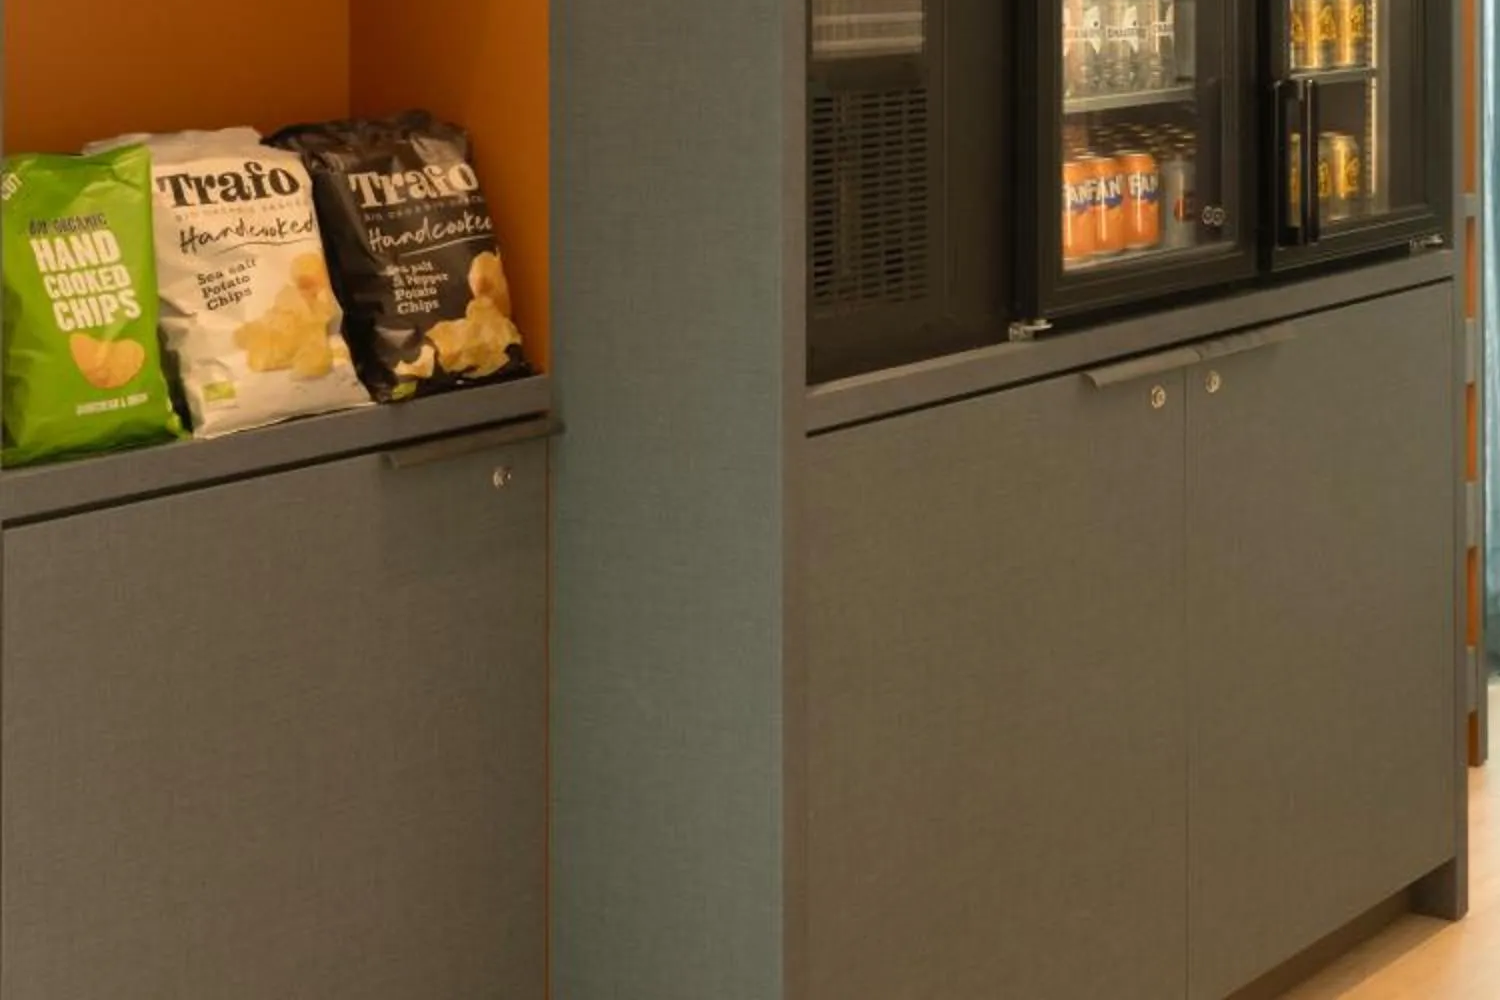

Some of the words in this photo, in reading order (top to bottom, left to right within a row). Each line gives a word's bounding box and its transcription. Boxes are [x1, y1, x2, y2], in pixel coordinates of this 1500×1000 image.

[155, 161, 299, 208] Trafo
[348, 163, 479, 208] Trafo
[30, 229, 121, 272] HAND
[43, 264, 131, 299] COOKED
[197, 271, 223, 286] Sea
[201, 275, 251, 298] Potato
[53, 289, 141, 331] CHIPS
[206, 288, 252, 311] Chips
[397, 300, 440, 315] Chips
